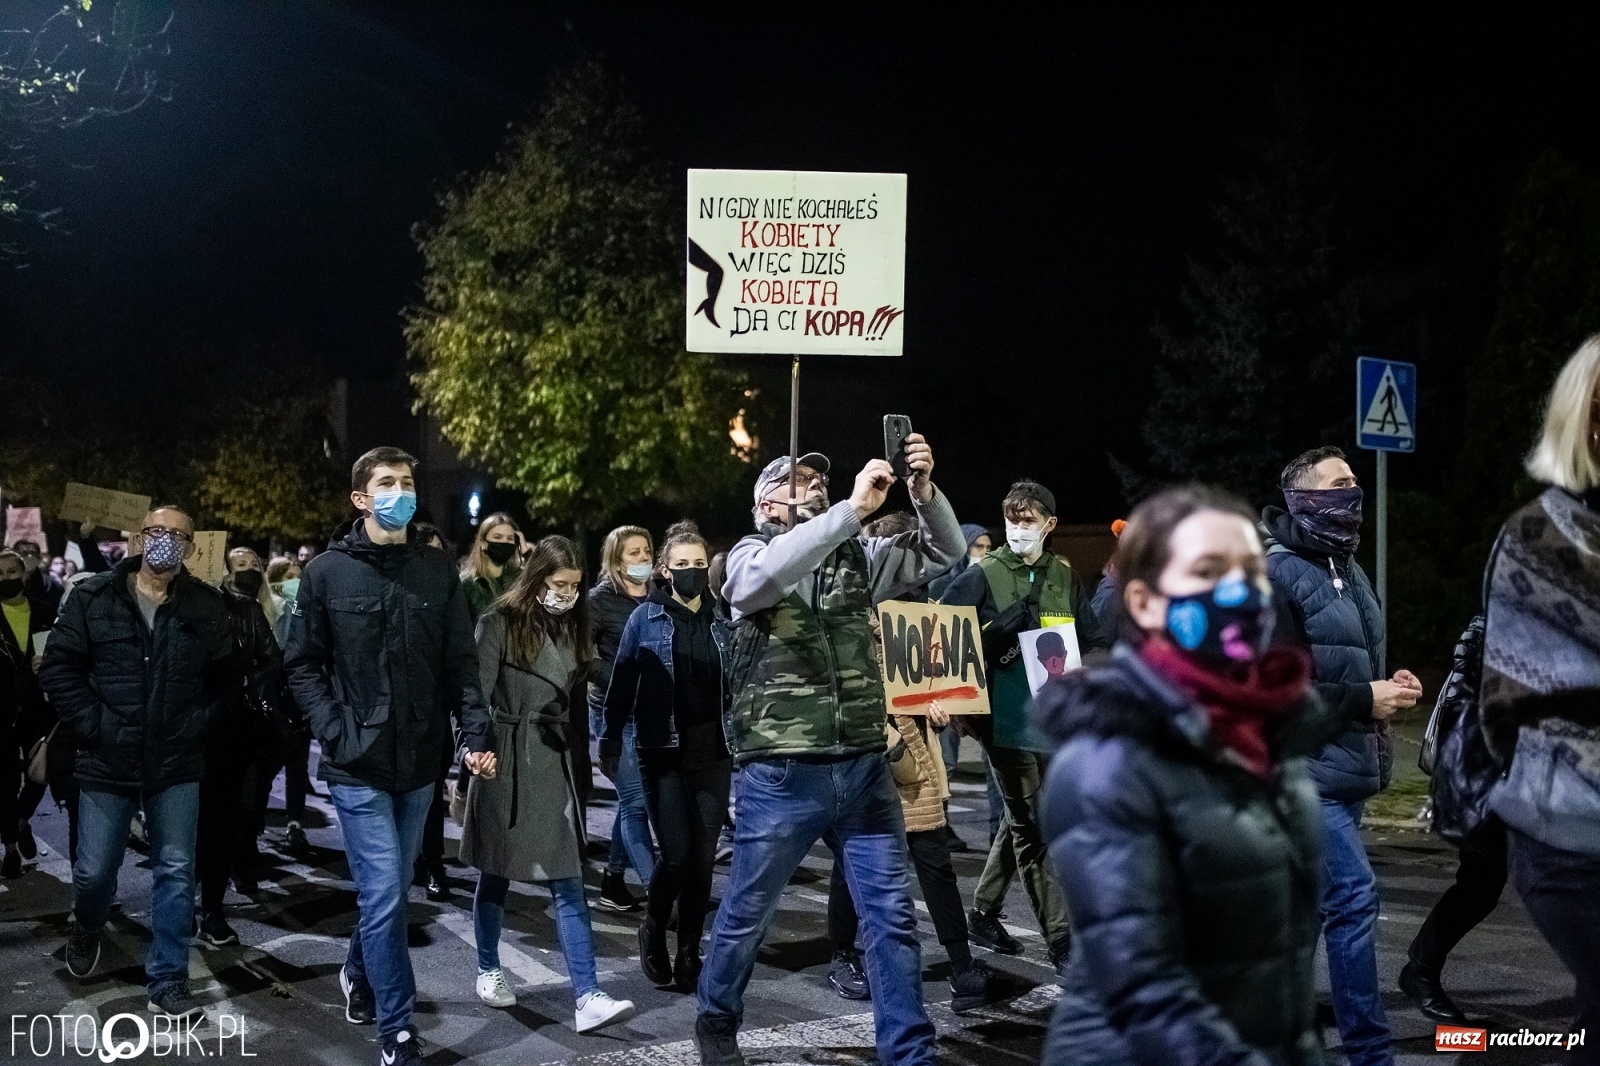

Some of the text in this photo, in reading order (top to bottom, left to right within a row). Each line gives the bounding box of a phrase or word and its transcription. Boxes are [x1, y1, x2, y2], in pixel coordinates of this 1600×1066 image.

[699, 193, 878, 219] NIGDY NIE KOCHAŁEŚ
[740, 221, 841, 248] KOBIETY
[728, 248, 846, 276] WIĘC DZIŚ
[740, 278, 838, 306] KOBIETA
[730, 306, 768, 338] DA
[778, 310, 797, 331] CI
